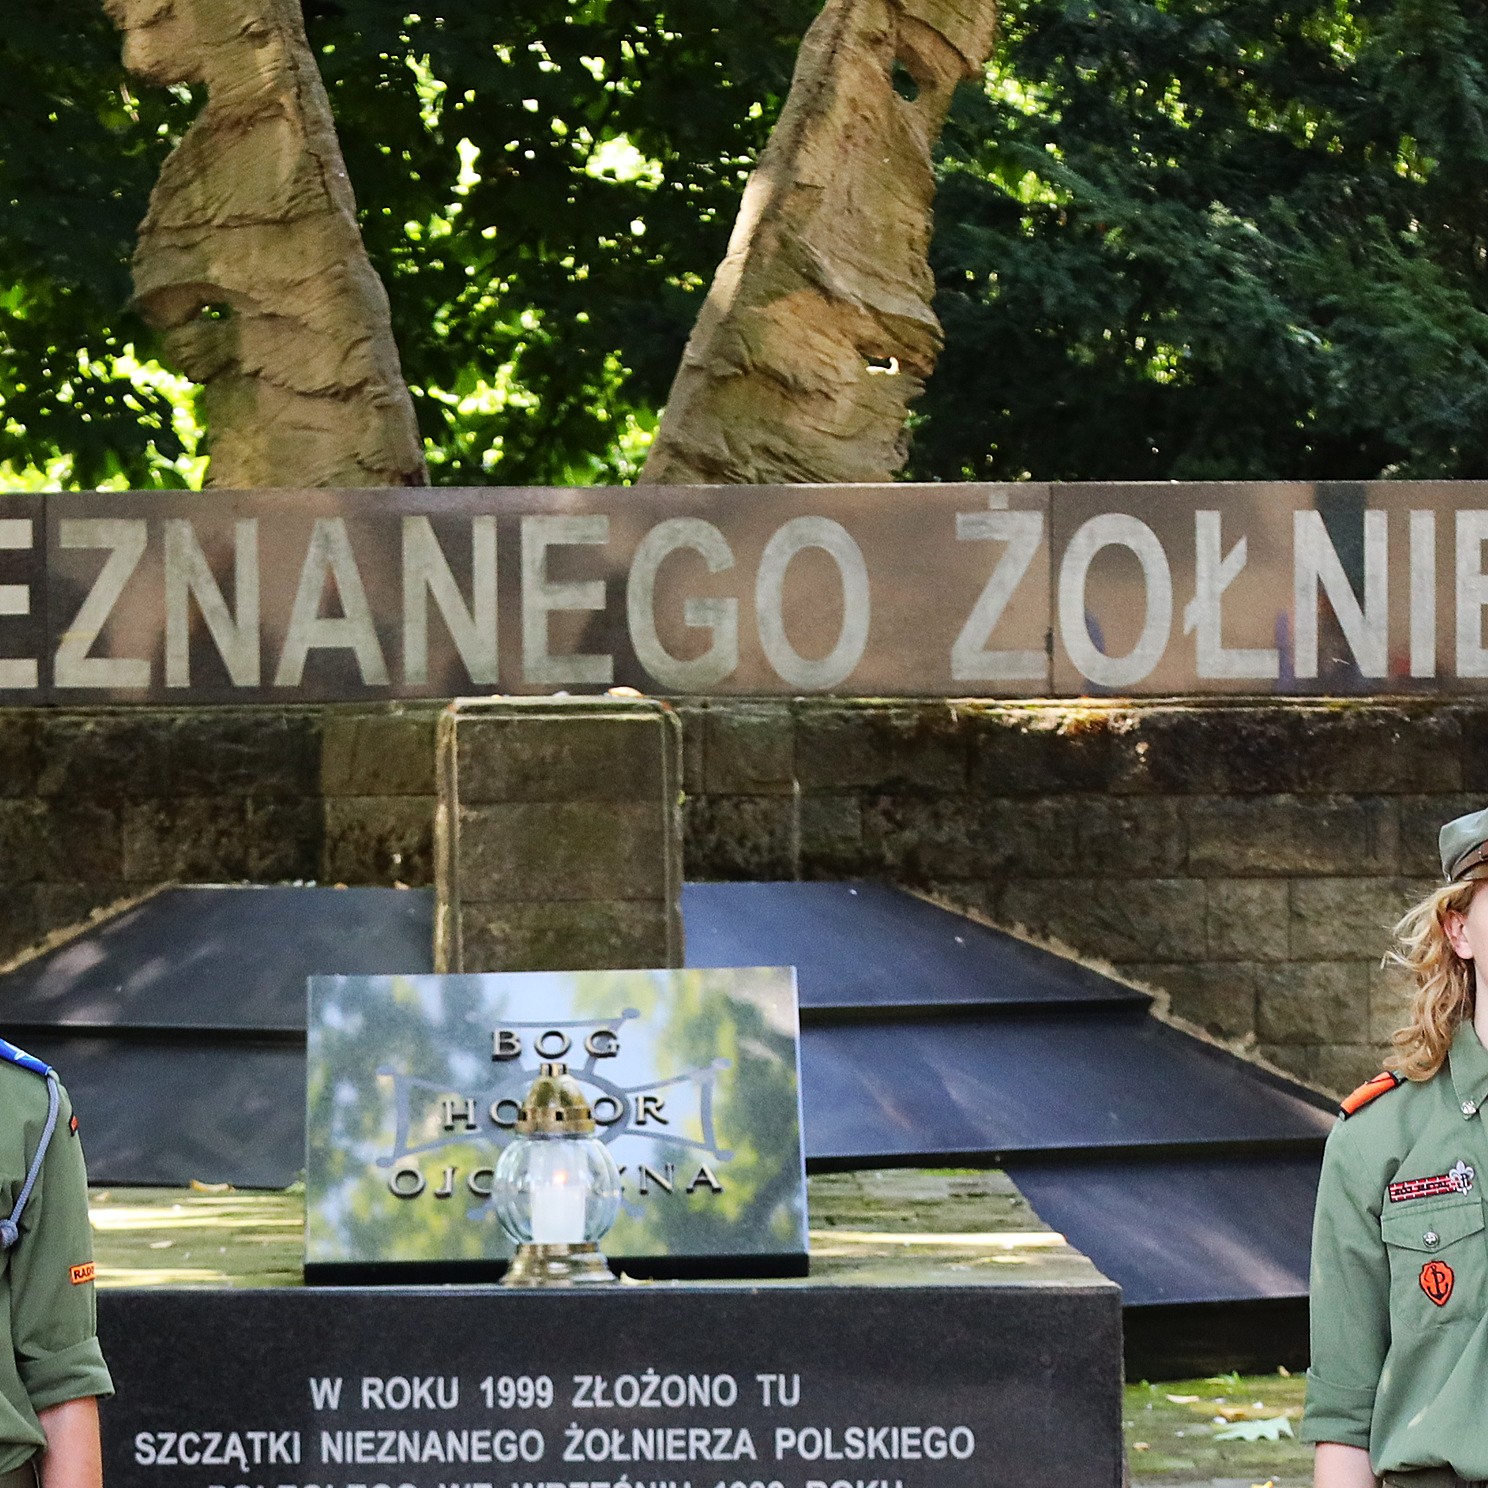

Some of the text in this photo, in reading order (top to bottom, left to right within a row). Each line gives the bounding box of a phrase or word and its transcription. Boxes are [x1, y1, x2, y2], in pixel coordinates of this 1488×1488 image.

[491, 1028, 621, 1062] BOG
[443, 1095, 669, 1132] HOOR
[389, 1163, 725, 1199] OJCNA
[309, 1367, 801, 1411] W ROKU 1999 ZŁOŻONO TU
[134, 1421, 975, 1472] SZCZĄTKI NIEZNANEGO ŻOŁNIERZA POLSKIEGO
